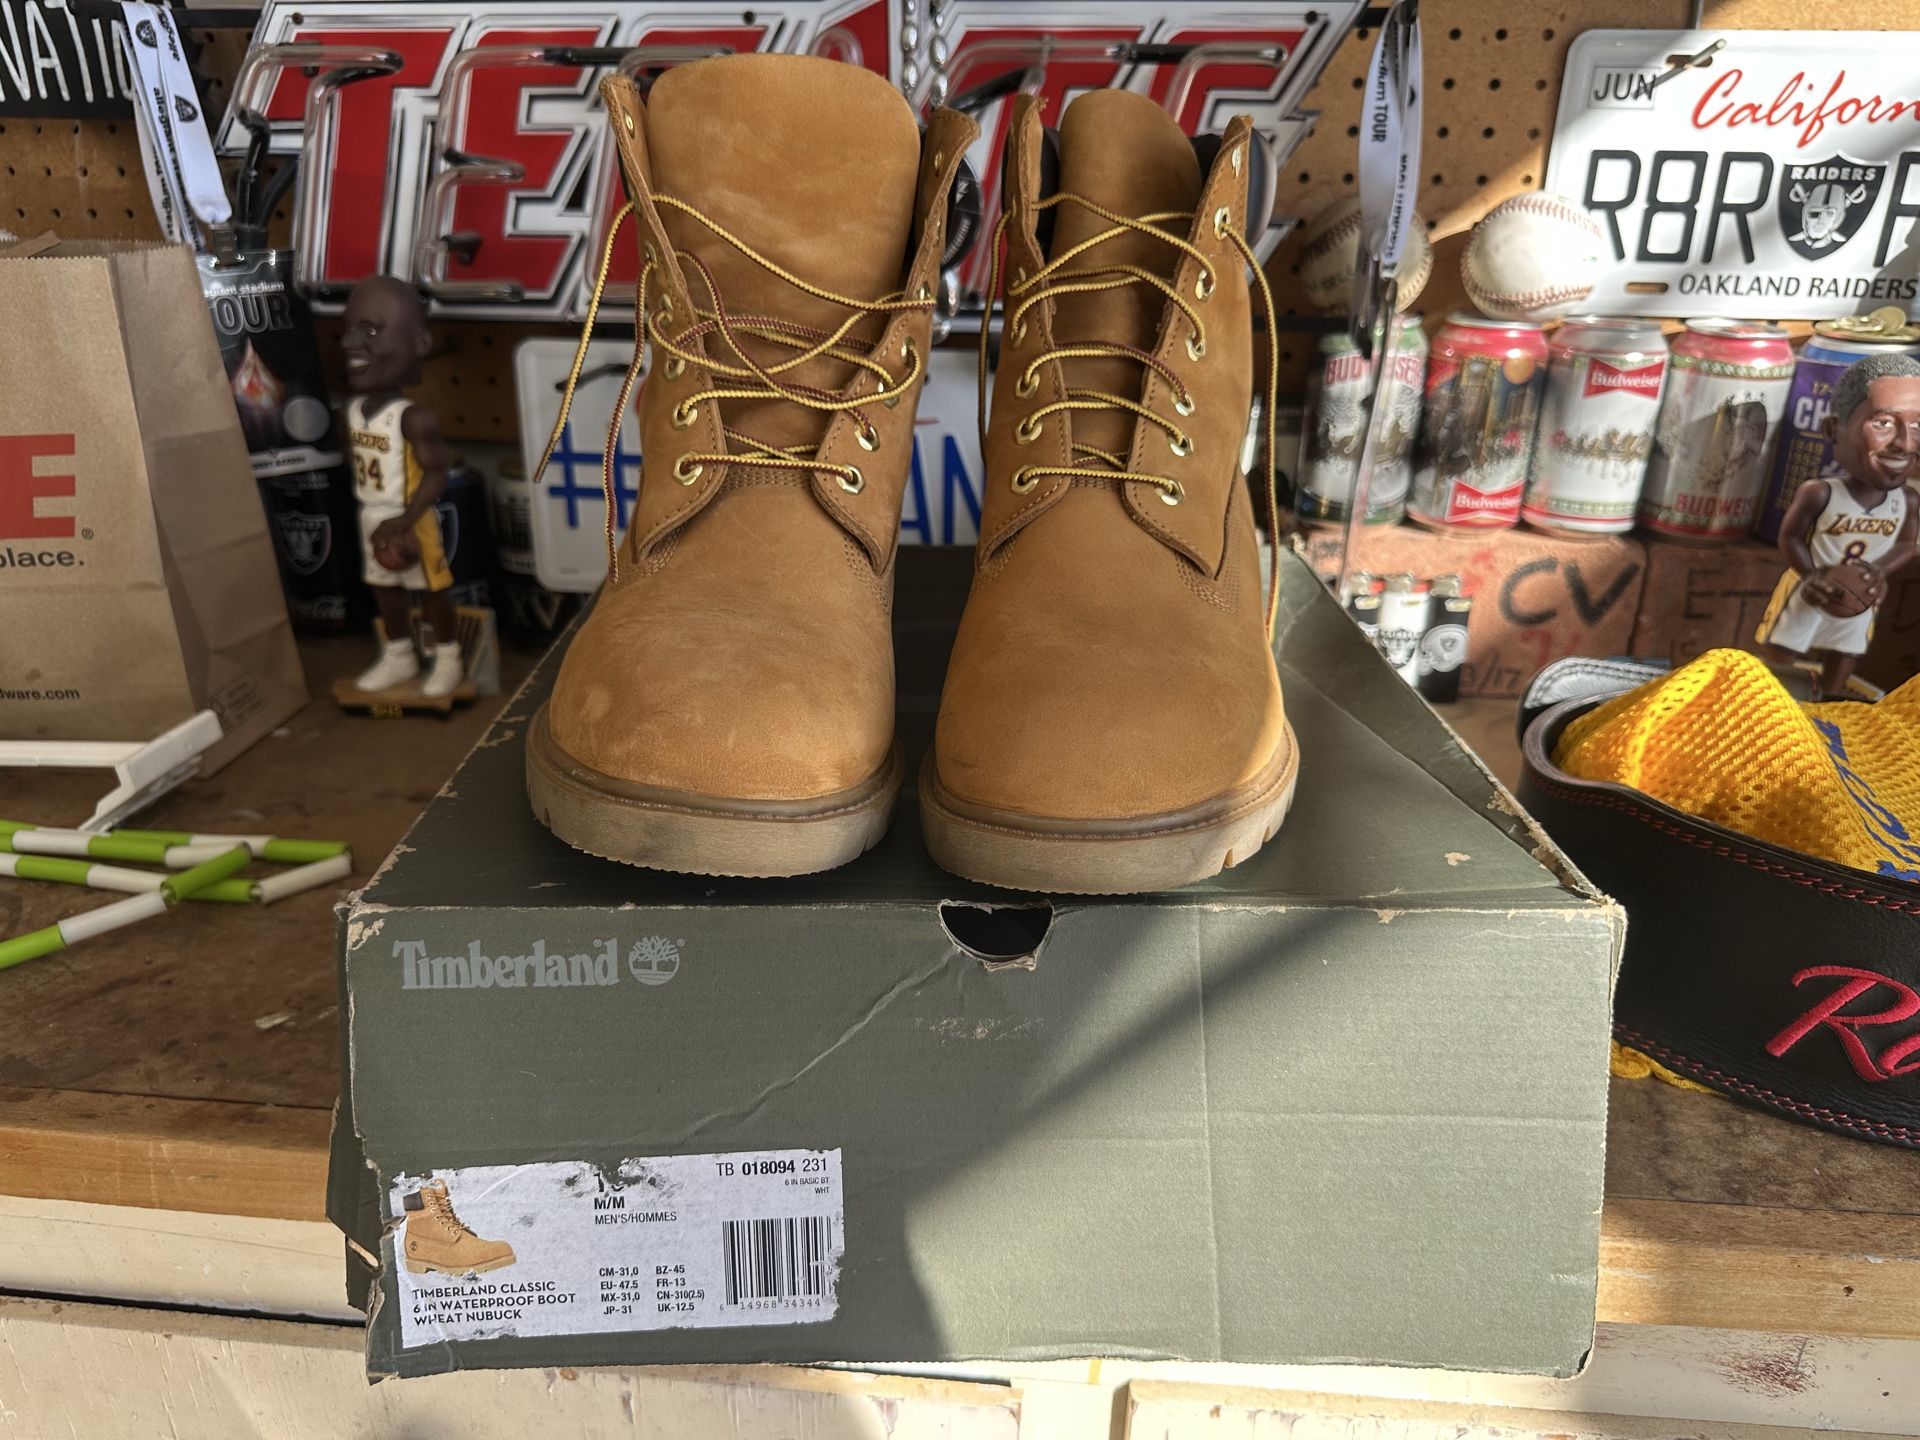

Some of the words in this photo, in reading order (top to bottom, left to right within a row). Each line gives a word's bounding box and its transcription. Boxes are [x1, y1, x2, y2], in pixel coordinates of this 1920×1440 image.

[1593, 73, 1657, 100] JUN
[1371, 103, 1389, 143] TOUR
[1790, 166, 1876, 181] RAIDERS
[1678, 274, 1800, 297] OAKLAND
[1807, 278, 1918, 300] RAIDERS
[209, 292, 295, 336] OUR
[1820, 513, 1899, 536] LAKERS
[1501, 556, 1639, 627] CV
[392, 938, 620, 990] Timberland
[716, 1162, 735, 1176] TB
[742, 1159, 796, 1176] 018094
[802, 1158, 827, 1172] 231
[784, 1178, 790, 1186] 6
[791, 1178, 798, 1186] IN
[799, 1177, 820, 1185] BASIC
[820, 1176, 830, 1184] BT
[593, 1196, 626, 1211] M/M
[594, 1211, 678, 1226] MEN'S/HOMMES
[412, 1284, 497, 1300] TIMBERLAND
[500, 1281, 556, 1294] CLASSIC
[413, 1303, 421, 1314] 6
[424, 1302, 437, 1312] IN
[440, 1295, 534, 1311] WATERPROOF
[538, 1293, 576, 1305] BOOT
[414, 1313, 463, 1326] WHEAT
[466, 1309, 522, 1322] NUBUCK
